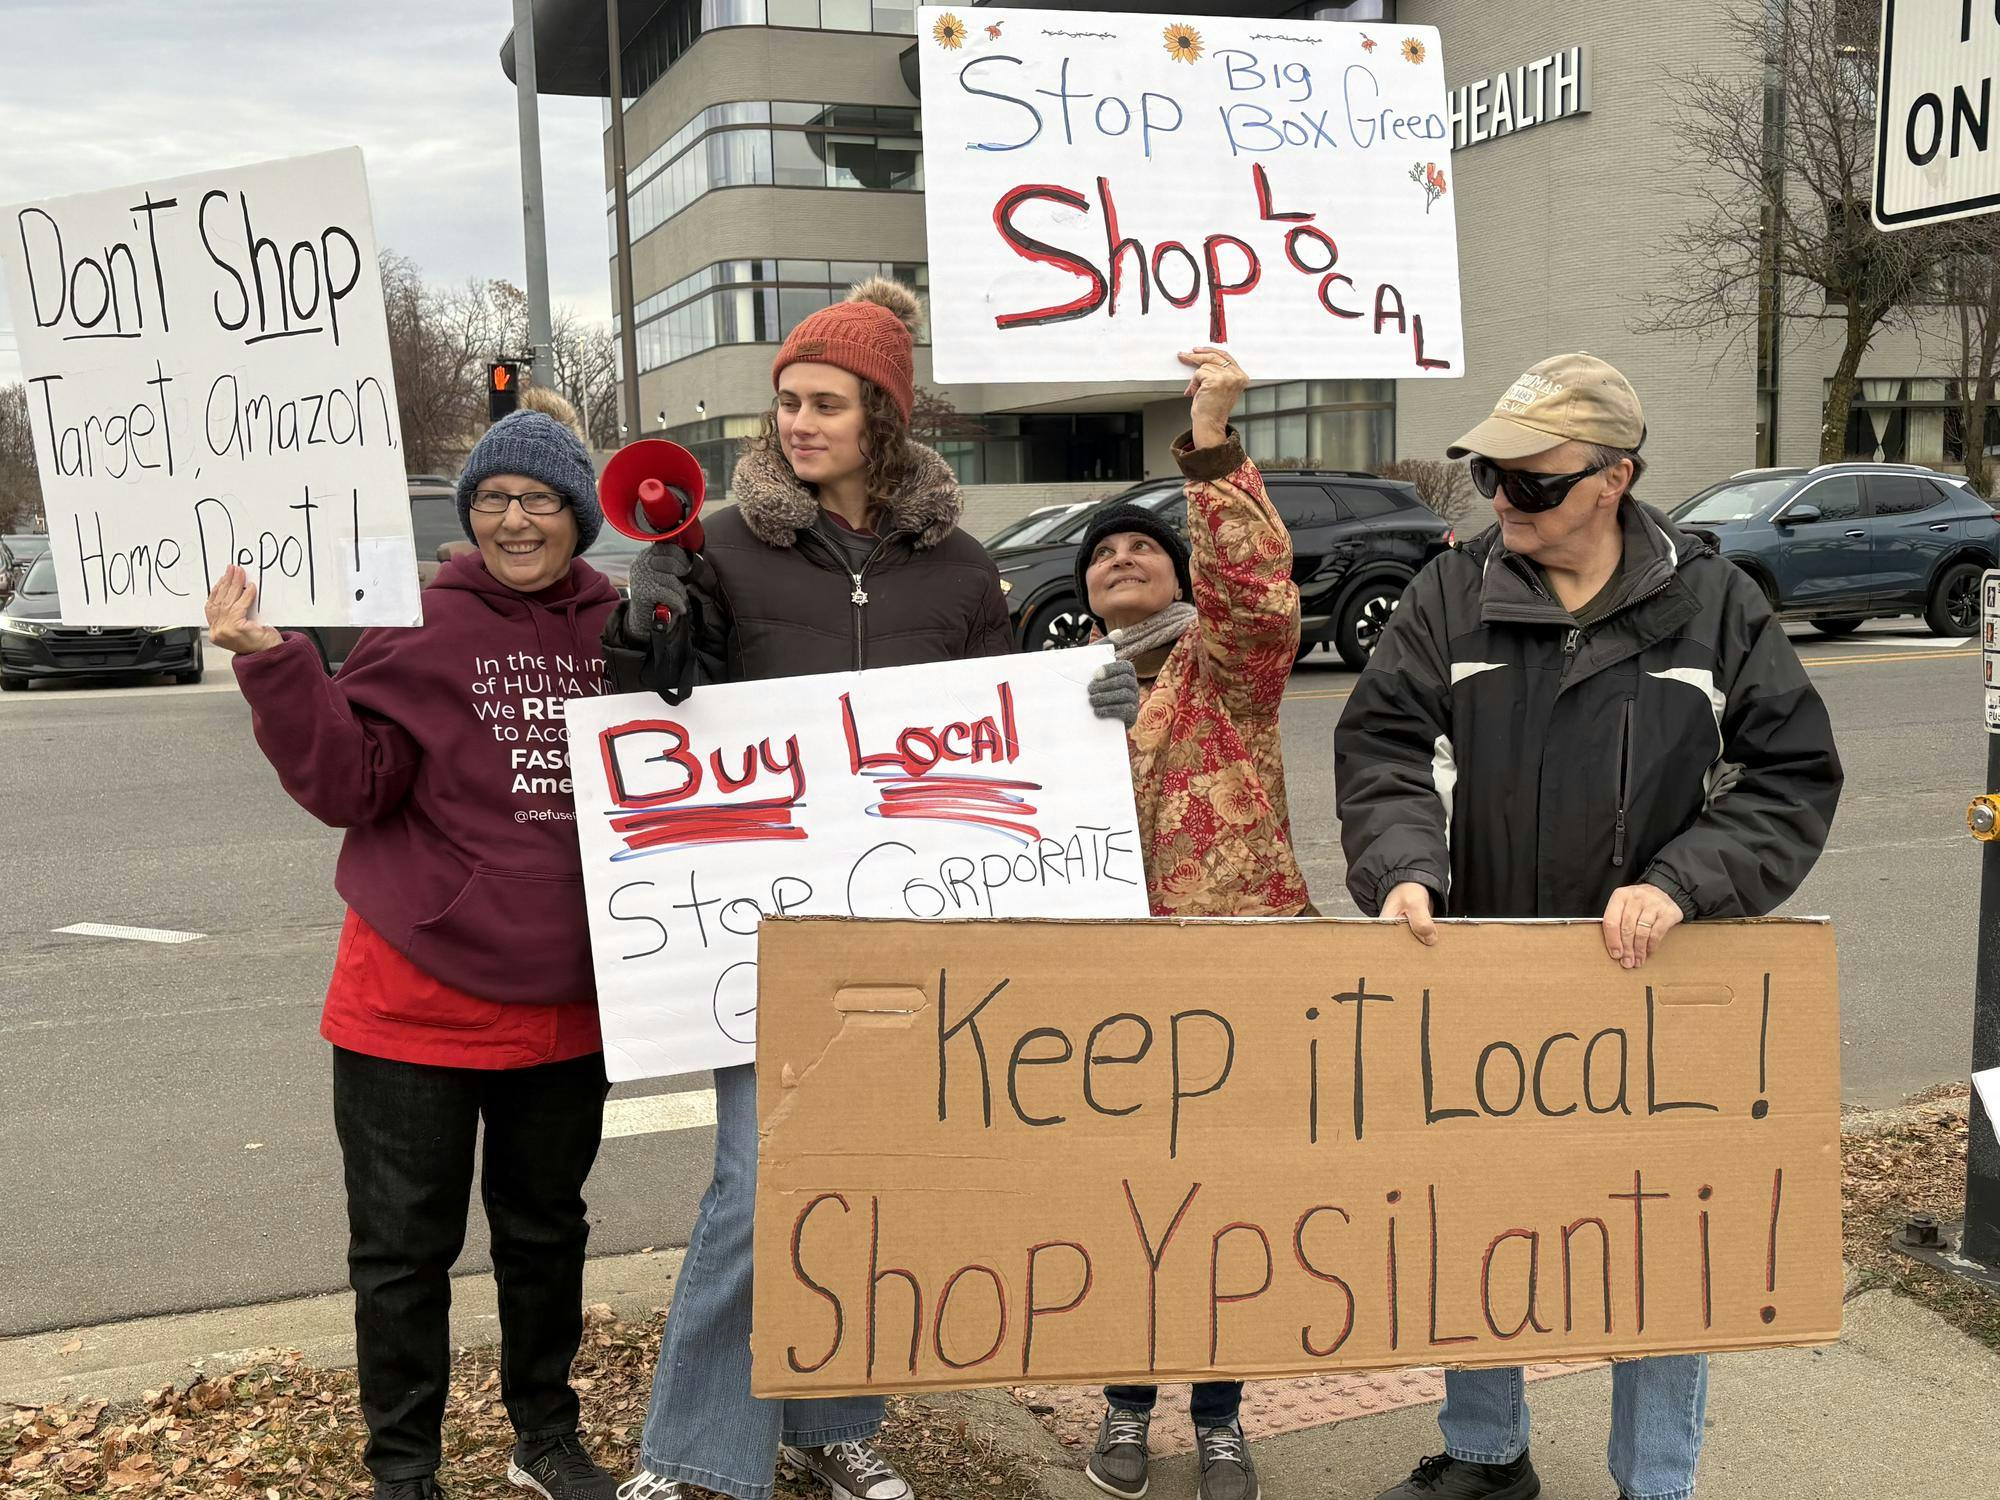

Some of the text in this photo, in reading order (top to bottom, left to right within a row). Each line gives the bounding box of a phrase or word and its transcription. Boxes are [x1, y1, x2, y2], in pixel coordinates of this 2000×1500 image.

[959, 55, 1183, 160] Stop
[1213, 49, 1313, 102] Big
[1448, 46, 1580, 150] HEALTH
[1220, 104, 1338, 157] Box
[1905, 77, 1991, 167] ON
[199, 189, 361, 347] Shop
[994, 162, 1450, 370] Shop LOCAL
[75, 511, 190, 606] Home
[472, 677, 496, 695] of
[475, 656, 500, 675] In
[507, 651, 547, 671] the
[472, 701, 515, 720] We
[493, 724, 519, 741] to
[599, 719, 806, 806] Buy
[939, 967, 1235, 1159] Keep
[787, 1192, 1092, 1384] Shop
